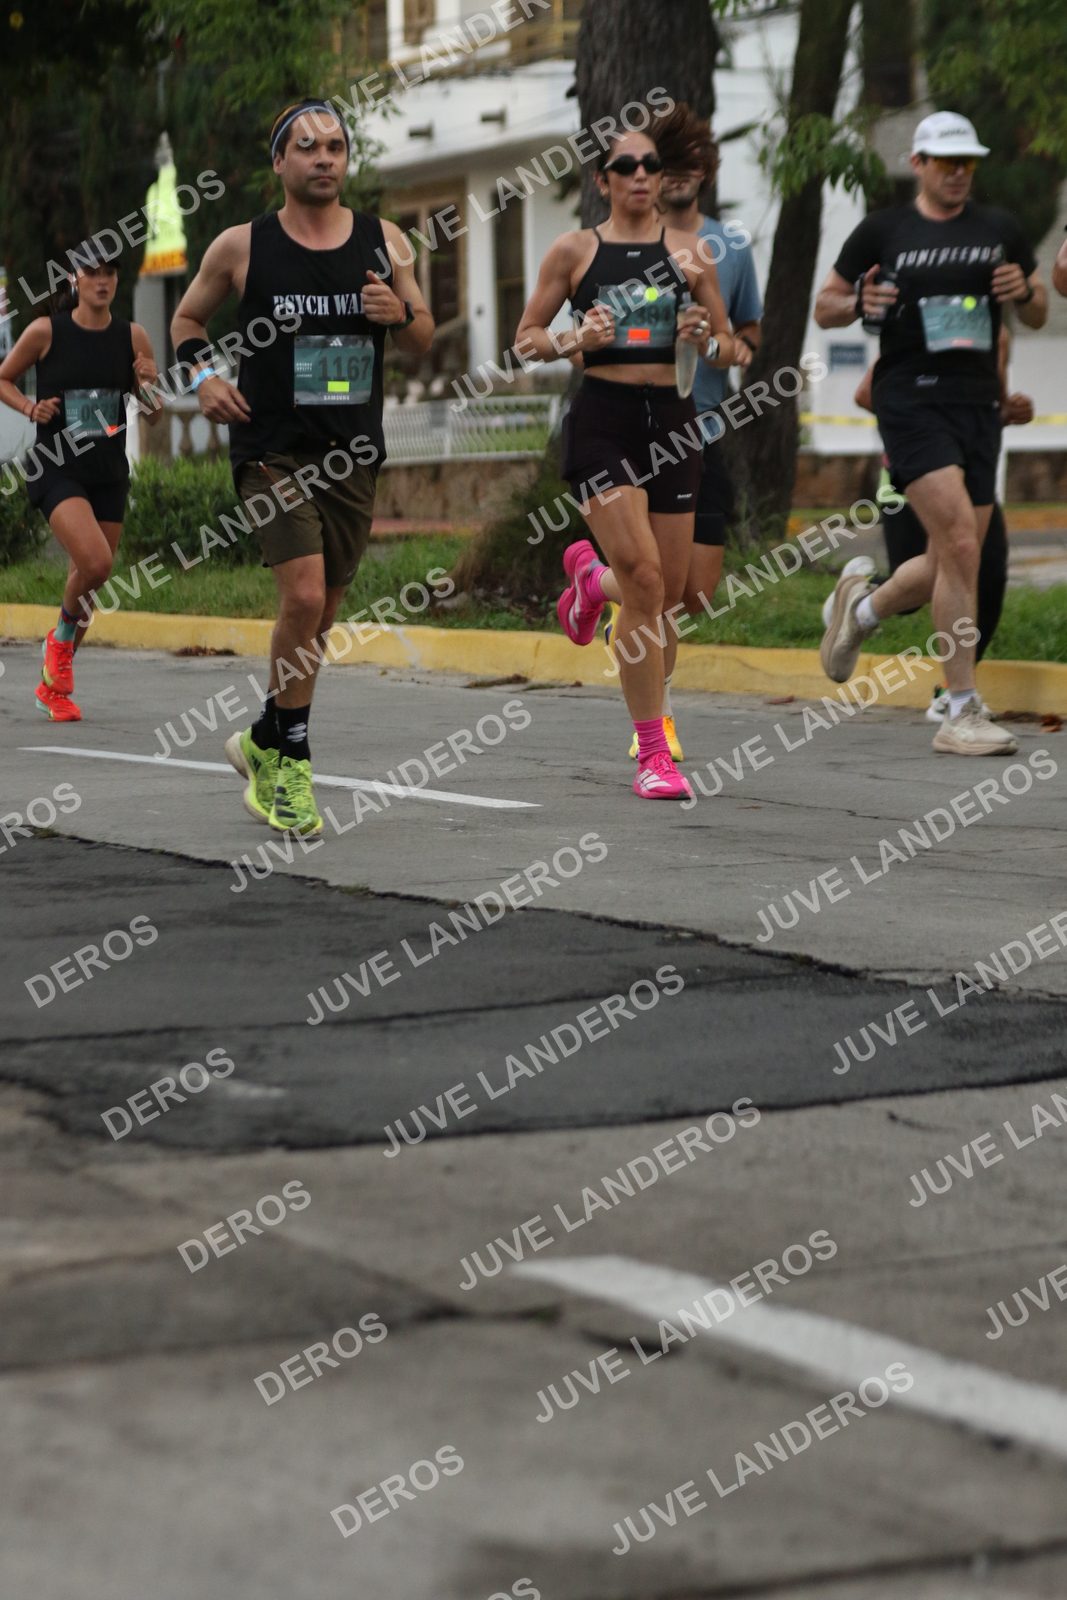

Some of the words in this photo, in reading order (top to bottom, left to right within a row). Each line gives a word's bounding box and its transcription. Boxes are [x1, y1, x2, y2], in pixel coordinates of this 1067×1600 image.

[273, 294, 330, 316] PSYCH
[333, 292, 366, 316] WA
[318, 355, 372, 382] 1167
